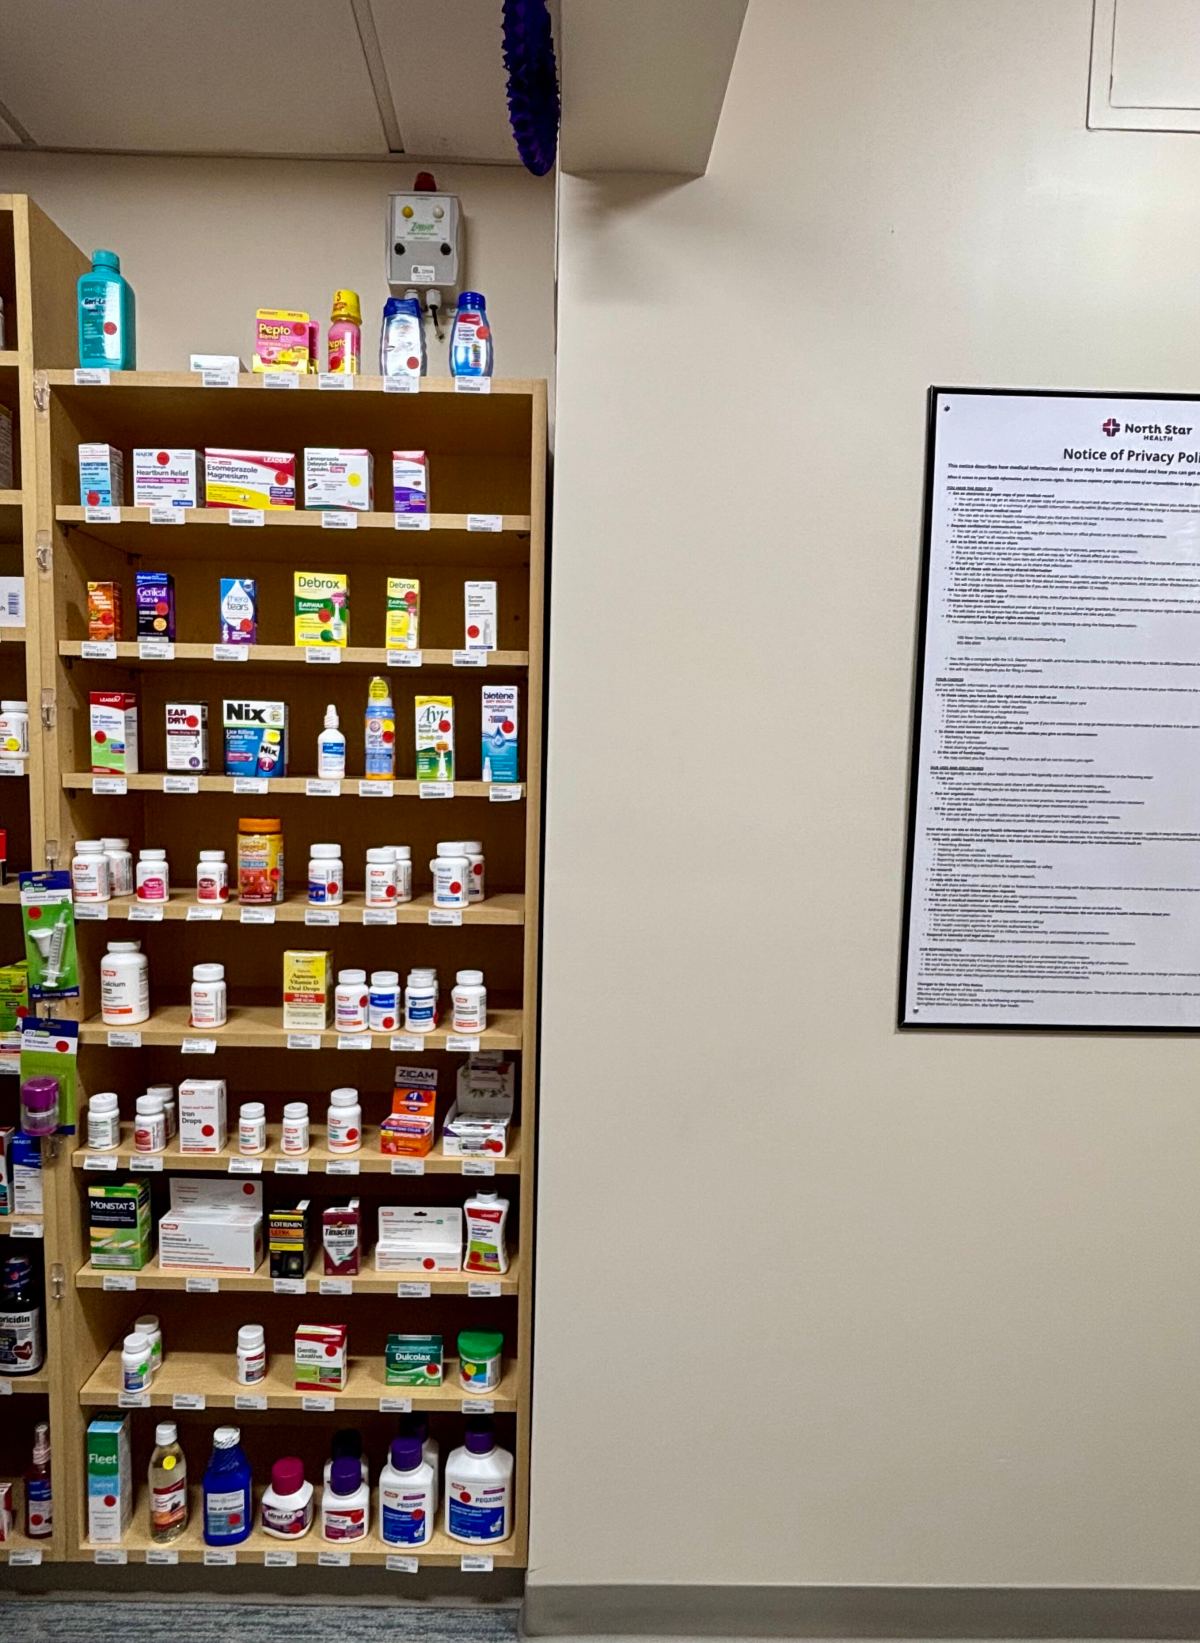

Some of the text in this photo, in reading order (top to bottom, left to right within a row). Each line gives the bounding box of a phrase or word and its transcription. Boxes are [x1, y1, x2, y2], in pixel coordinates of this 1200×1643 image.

[258, 323, 291, 336] Pepto
[1124, 424, 1193, 435] North Star
[1063, 448, 1106, 460] Notice
[1110, 449, 1124, 461] of
[1128, 450, 1174, 465] Privacy
[207, 465, 258, 474] Esomeprazole
[207, 472, 248, 480] Magnesium
[298, 577, 340, 589] Debrox
[389, 581, 416, 589] Debrox
[228, 594, 249, 604] thera
[227, 600, 249, 610] tears
[227, 704, 266, 724] Nix
[419, 706, 449, 723] Ayr
[168, 717, 186, 725] DRY
[260, 746, 278, 756] Nix
[399, 1070, 435, 1079] ZICAM
[90, 1200, 136, 1210] MONISTAT 3
[395, 1353, 431, 1361] Dulcolax
[88, 1454, 117, 1464] Fleet
[268, 1511, 293, 1520] MiraLAX
